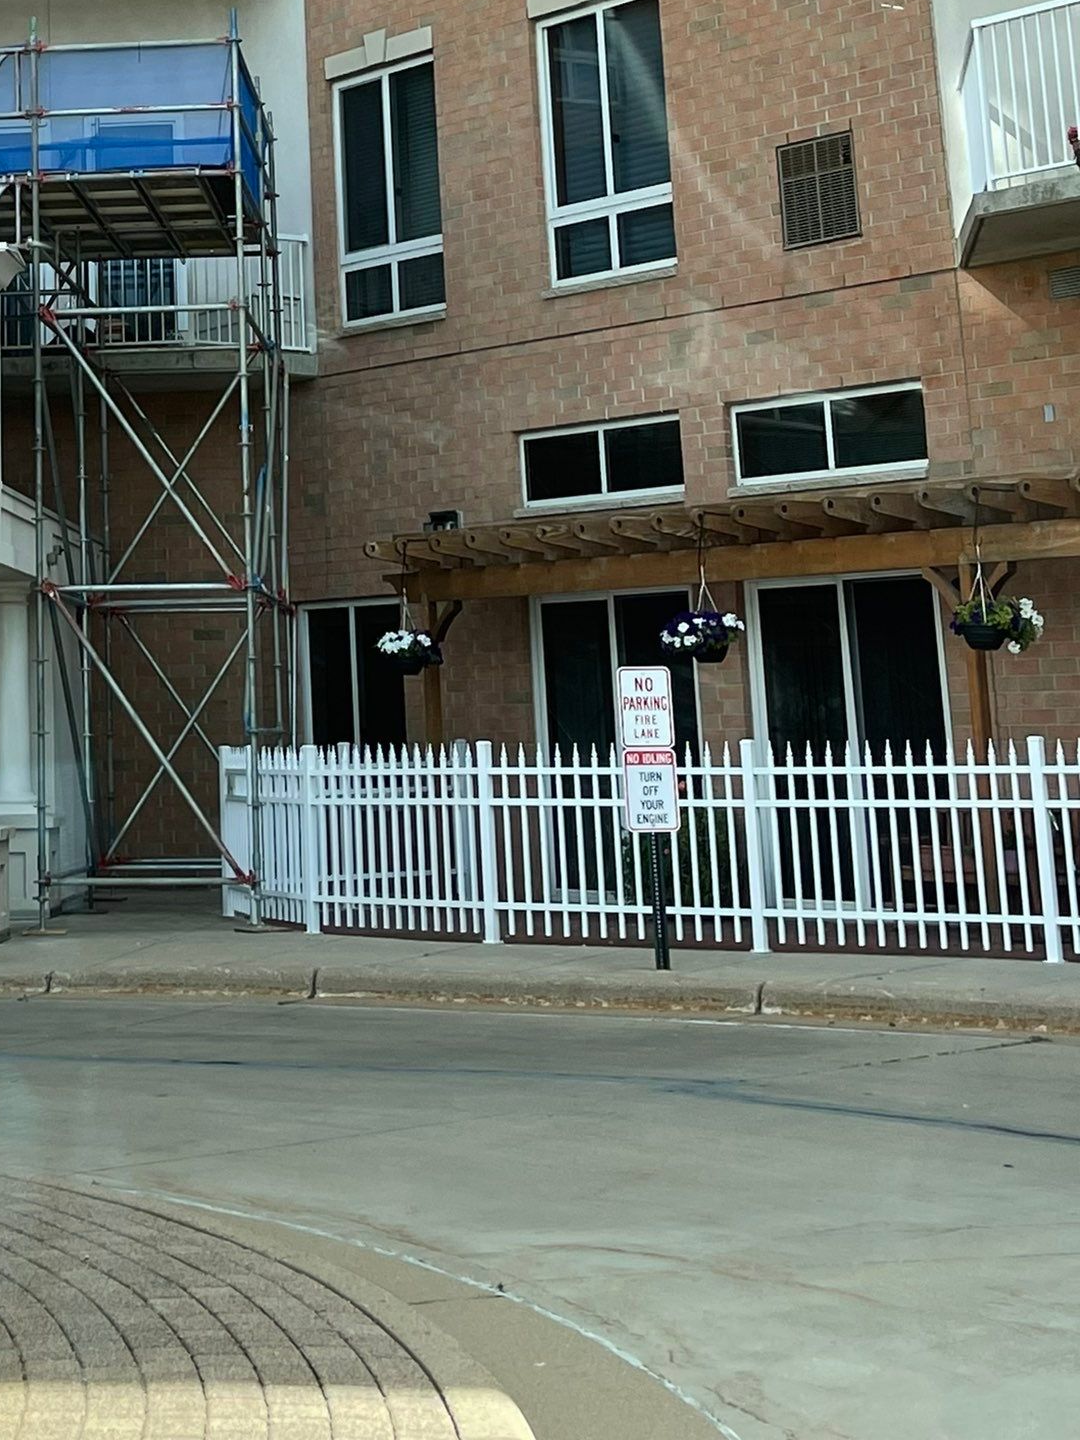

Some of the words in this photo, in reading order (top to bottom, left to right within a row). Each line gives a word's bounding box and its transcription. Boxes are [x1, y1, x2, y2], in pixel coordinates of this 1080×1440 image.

[634, 677, 654, 692] NO
[623, 696, 668, 711] PARKING
[635, 714, 658, 725] FIRE
[634, 728, 660, 739] LANE
[626, 753, 639, 764] NO
[642, 753, 672, 764] IDLING
[638, 771, 663, 782] TURN
[642, 785, 659, 796] OFF
[640, 799, 664, 810] YOUR
[637, 813, 669, 824] ENGINE
